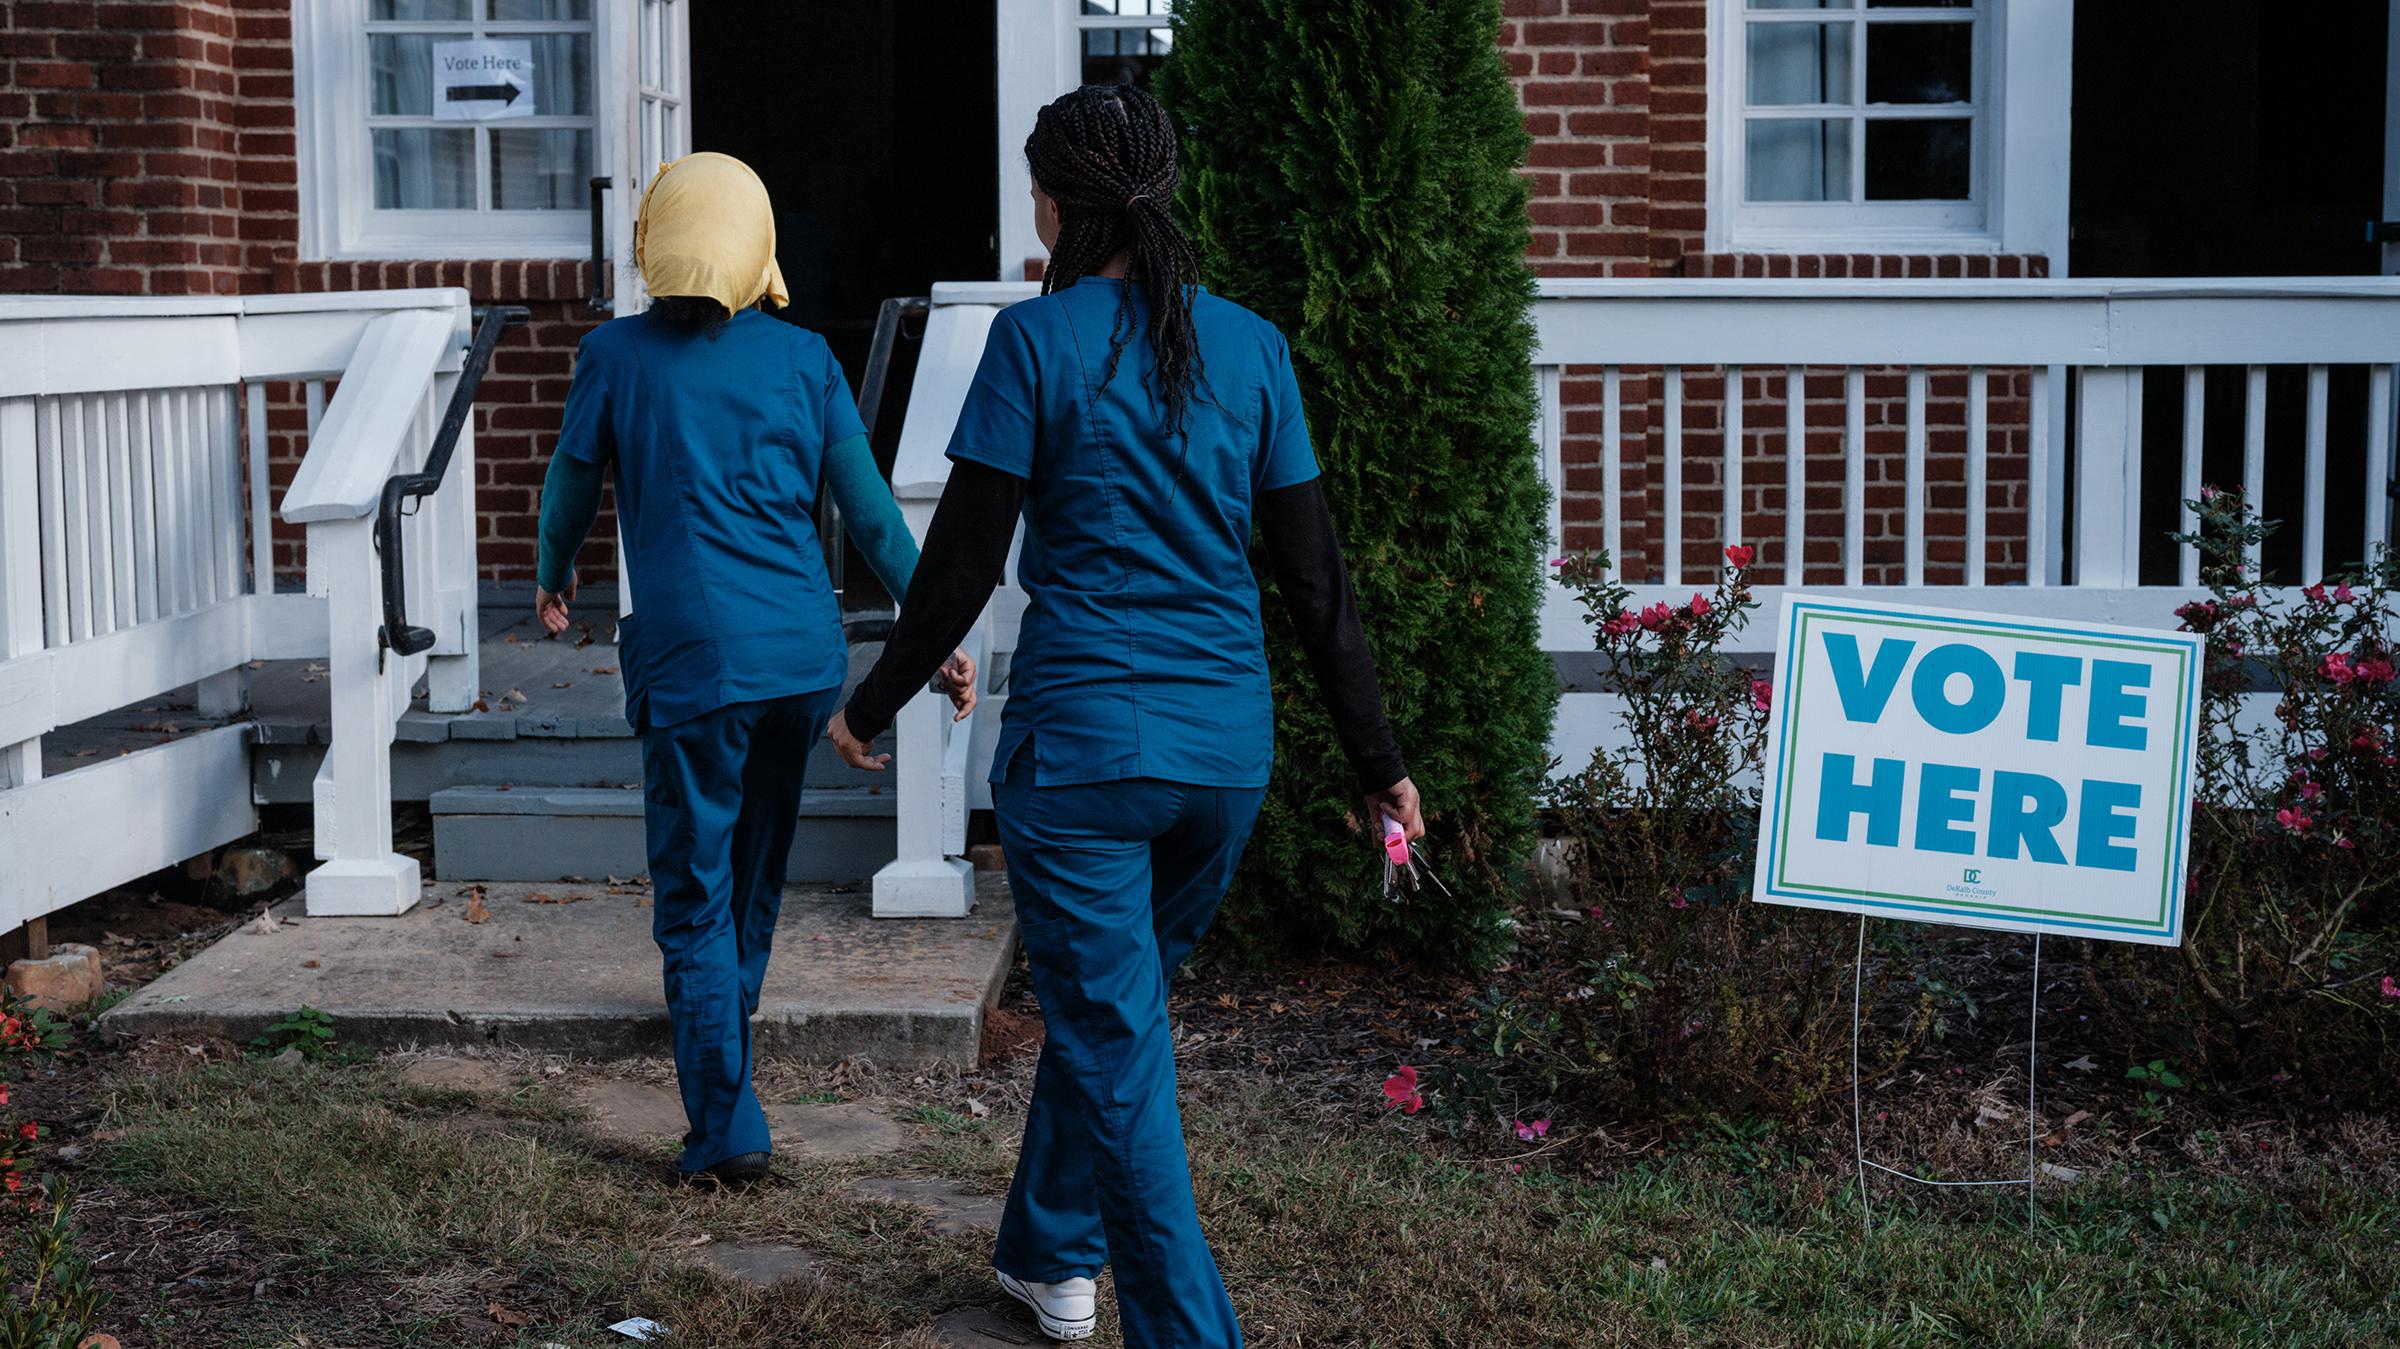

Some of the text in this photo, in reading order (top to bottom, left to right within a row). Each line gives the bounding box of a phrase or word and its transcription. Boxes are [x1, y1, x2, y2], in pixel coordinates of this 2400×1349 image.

[444, 55, 521, 71] Vote Here
[1822, 632, 2152, 751] VOTE
[1816, 753, 2142, 872] HERE
[1963, 868, 1982, 884] DC
[1946, 884, 1971, 894] DeKalb
[1972, 887, 1997, 898] County
